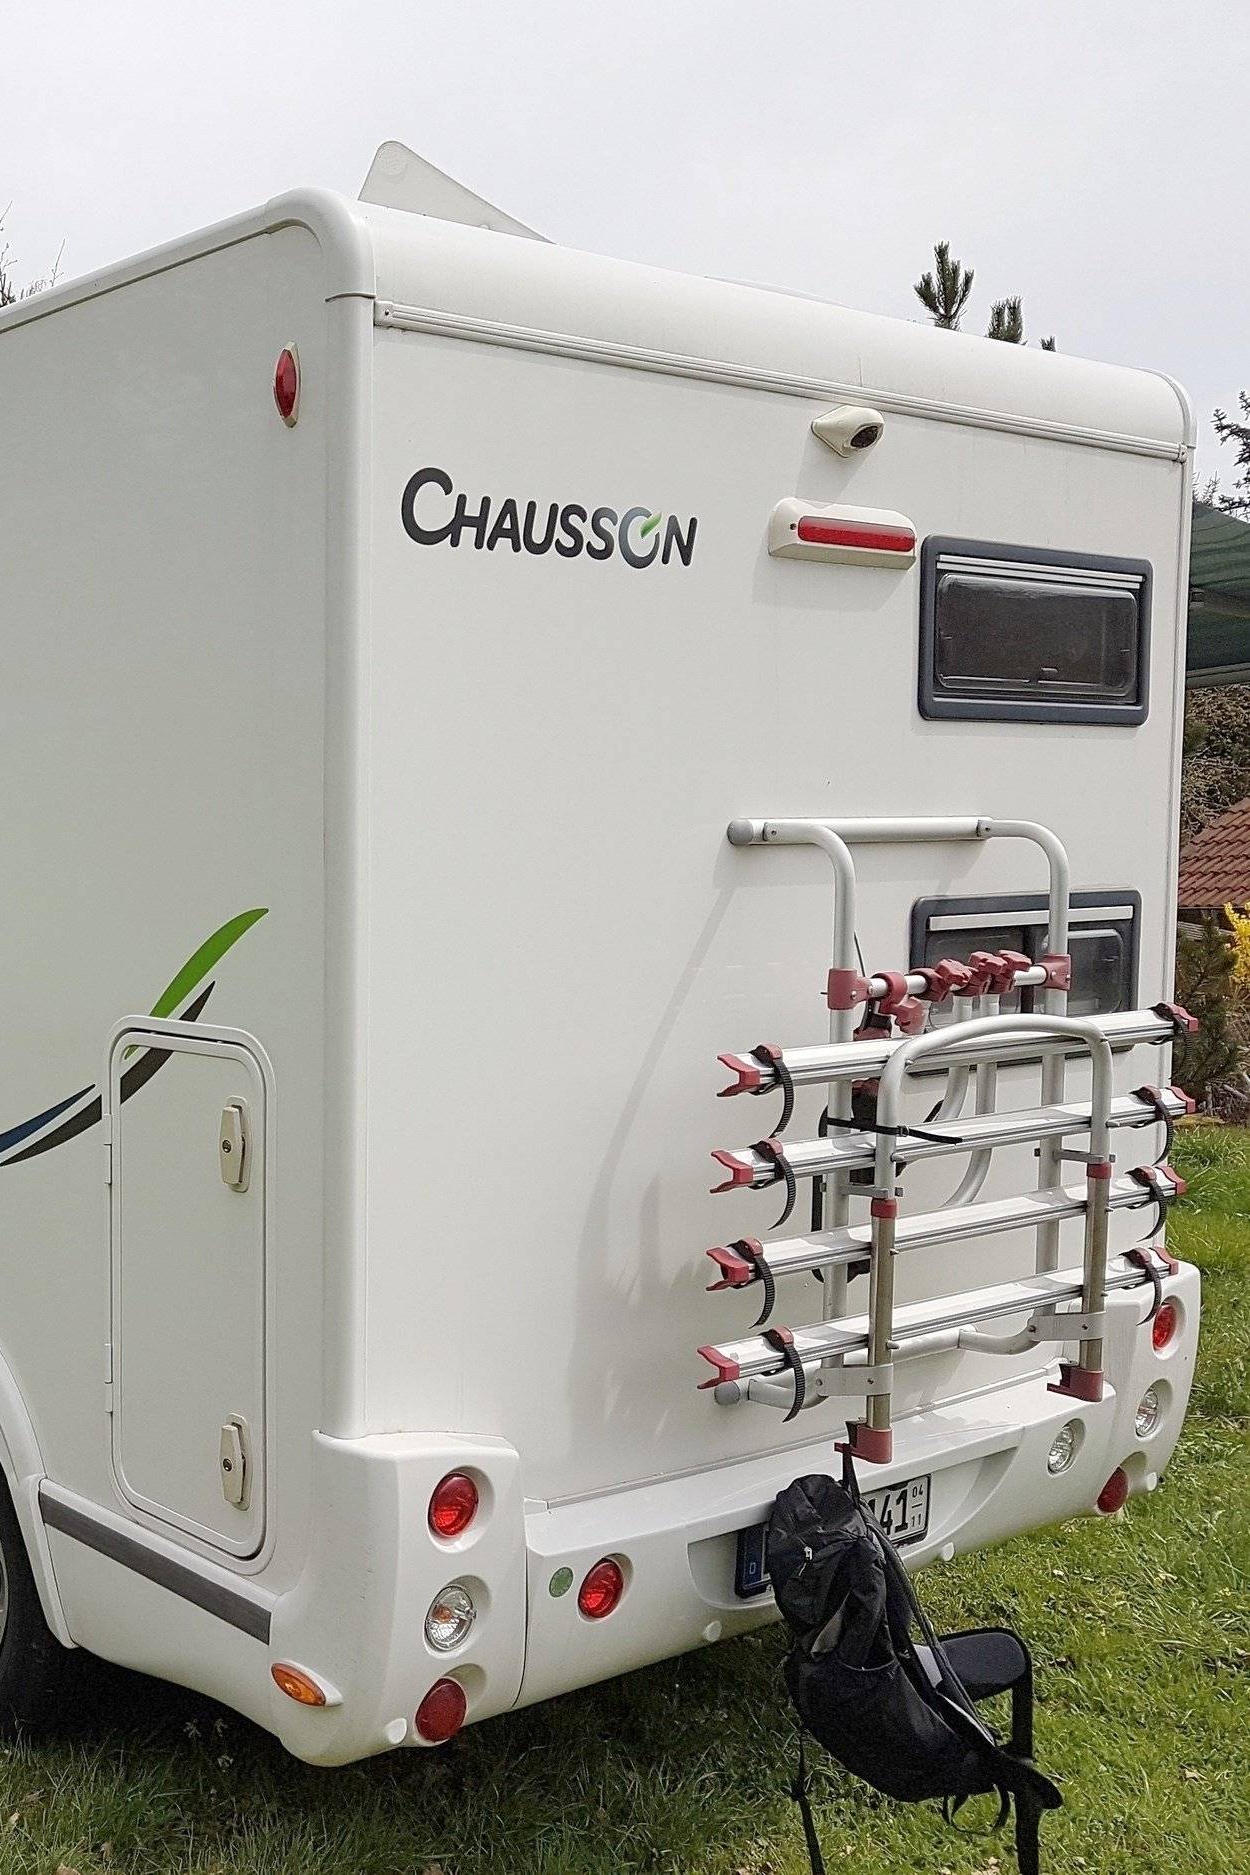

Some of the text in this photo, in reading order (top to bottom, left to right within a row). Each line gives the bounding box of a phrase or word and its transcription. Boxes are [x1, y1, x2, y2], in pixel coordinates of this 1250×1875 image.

[401, 467, 698, 569] CHAUSSON
[912, 1484, 923, 1498] 04
[912, 1513, 922, 1527] 11
